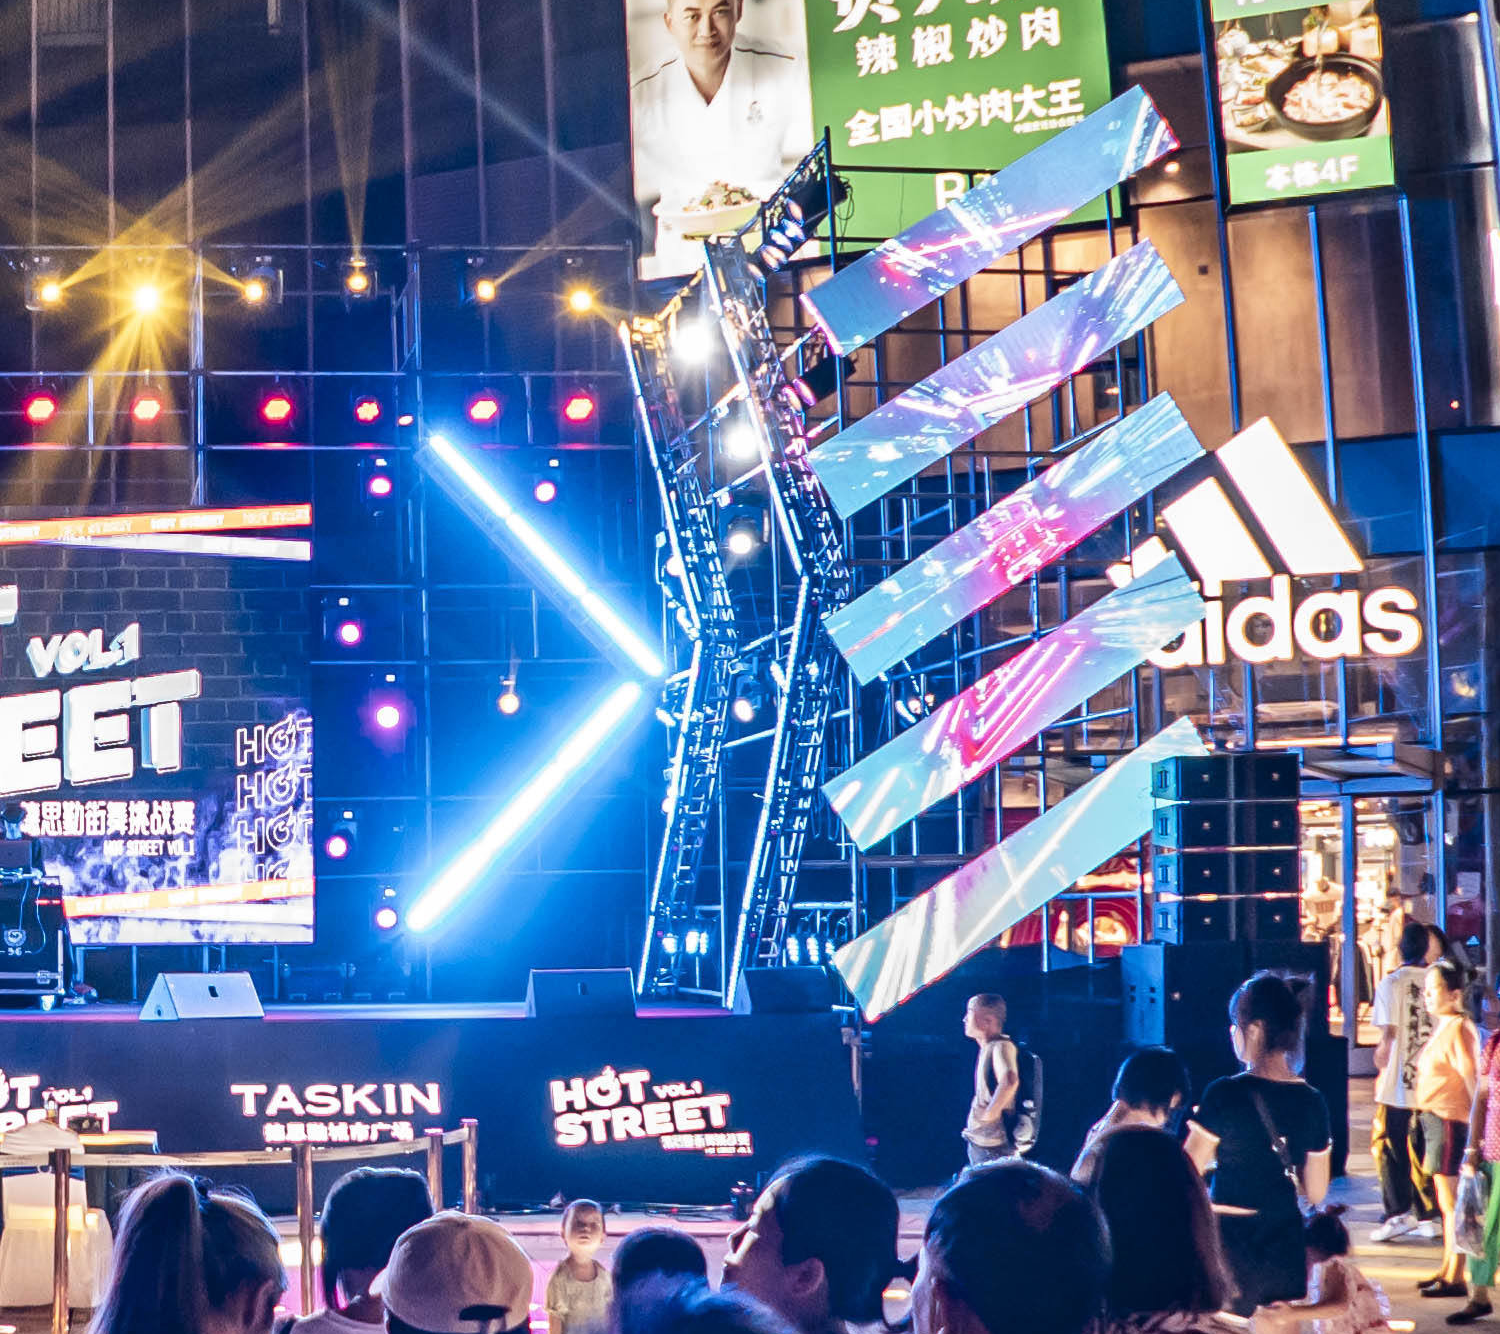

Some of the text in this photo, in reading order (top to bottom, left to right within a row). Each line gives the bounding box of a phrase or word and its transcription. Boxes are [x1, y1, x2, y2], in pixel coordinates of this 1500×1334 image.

[855, 5, 1063, 78] 辣椒炒肉
[844, 78, 1086, 147] 全国小炒肉大王
[1146, 573, 1425, 669] idas
[230, 1082, 442, 1117] TASKIN
[549, 1064, 651, 1113] HOT
[554, 1093, 731, 1147] STREET
